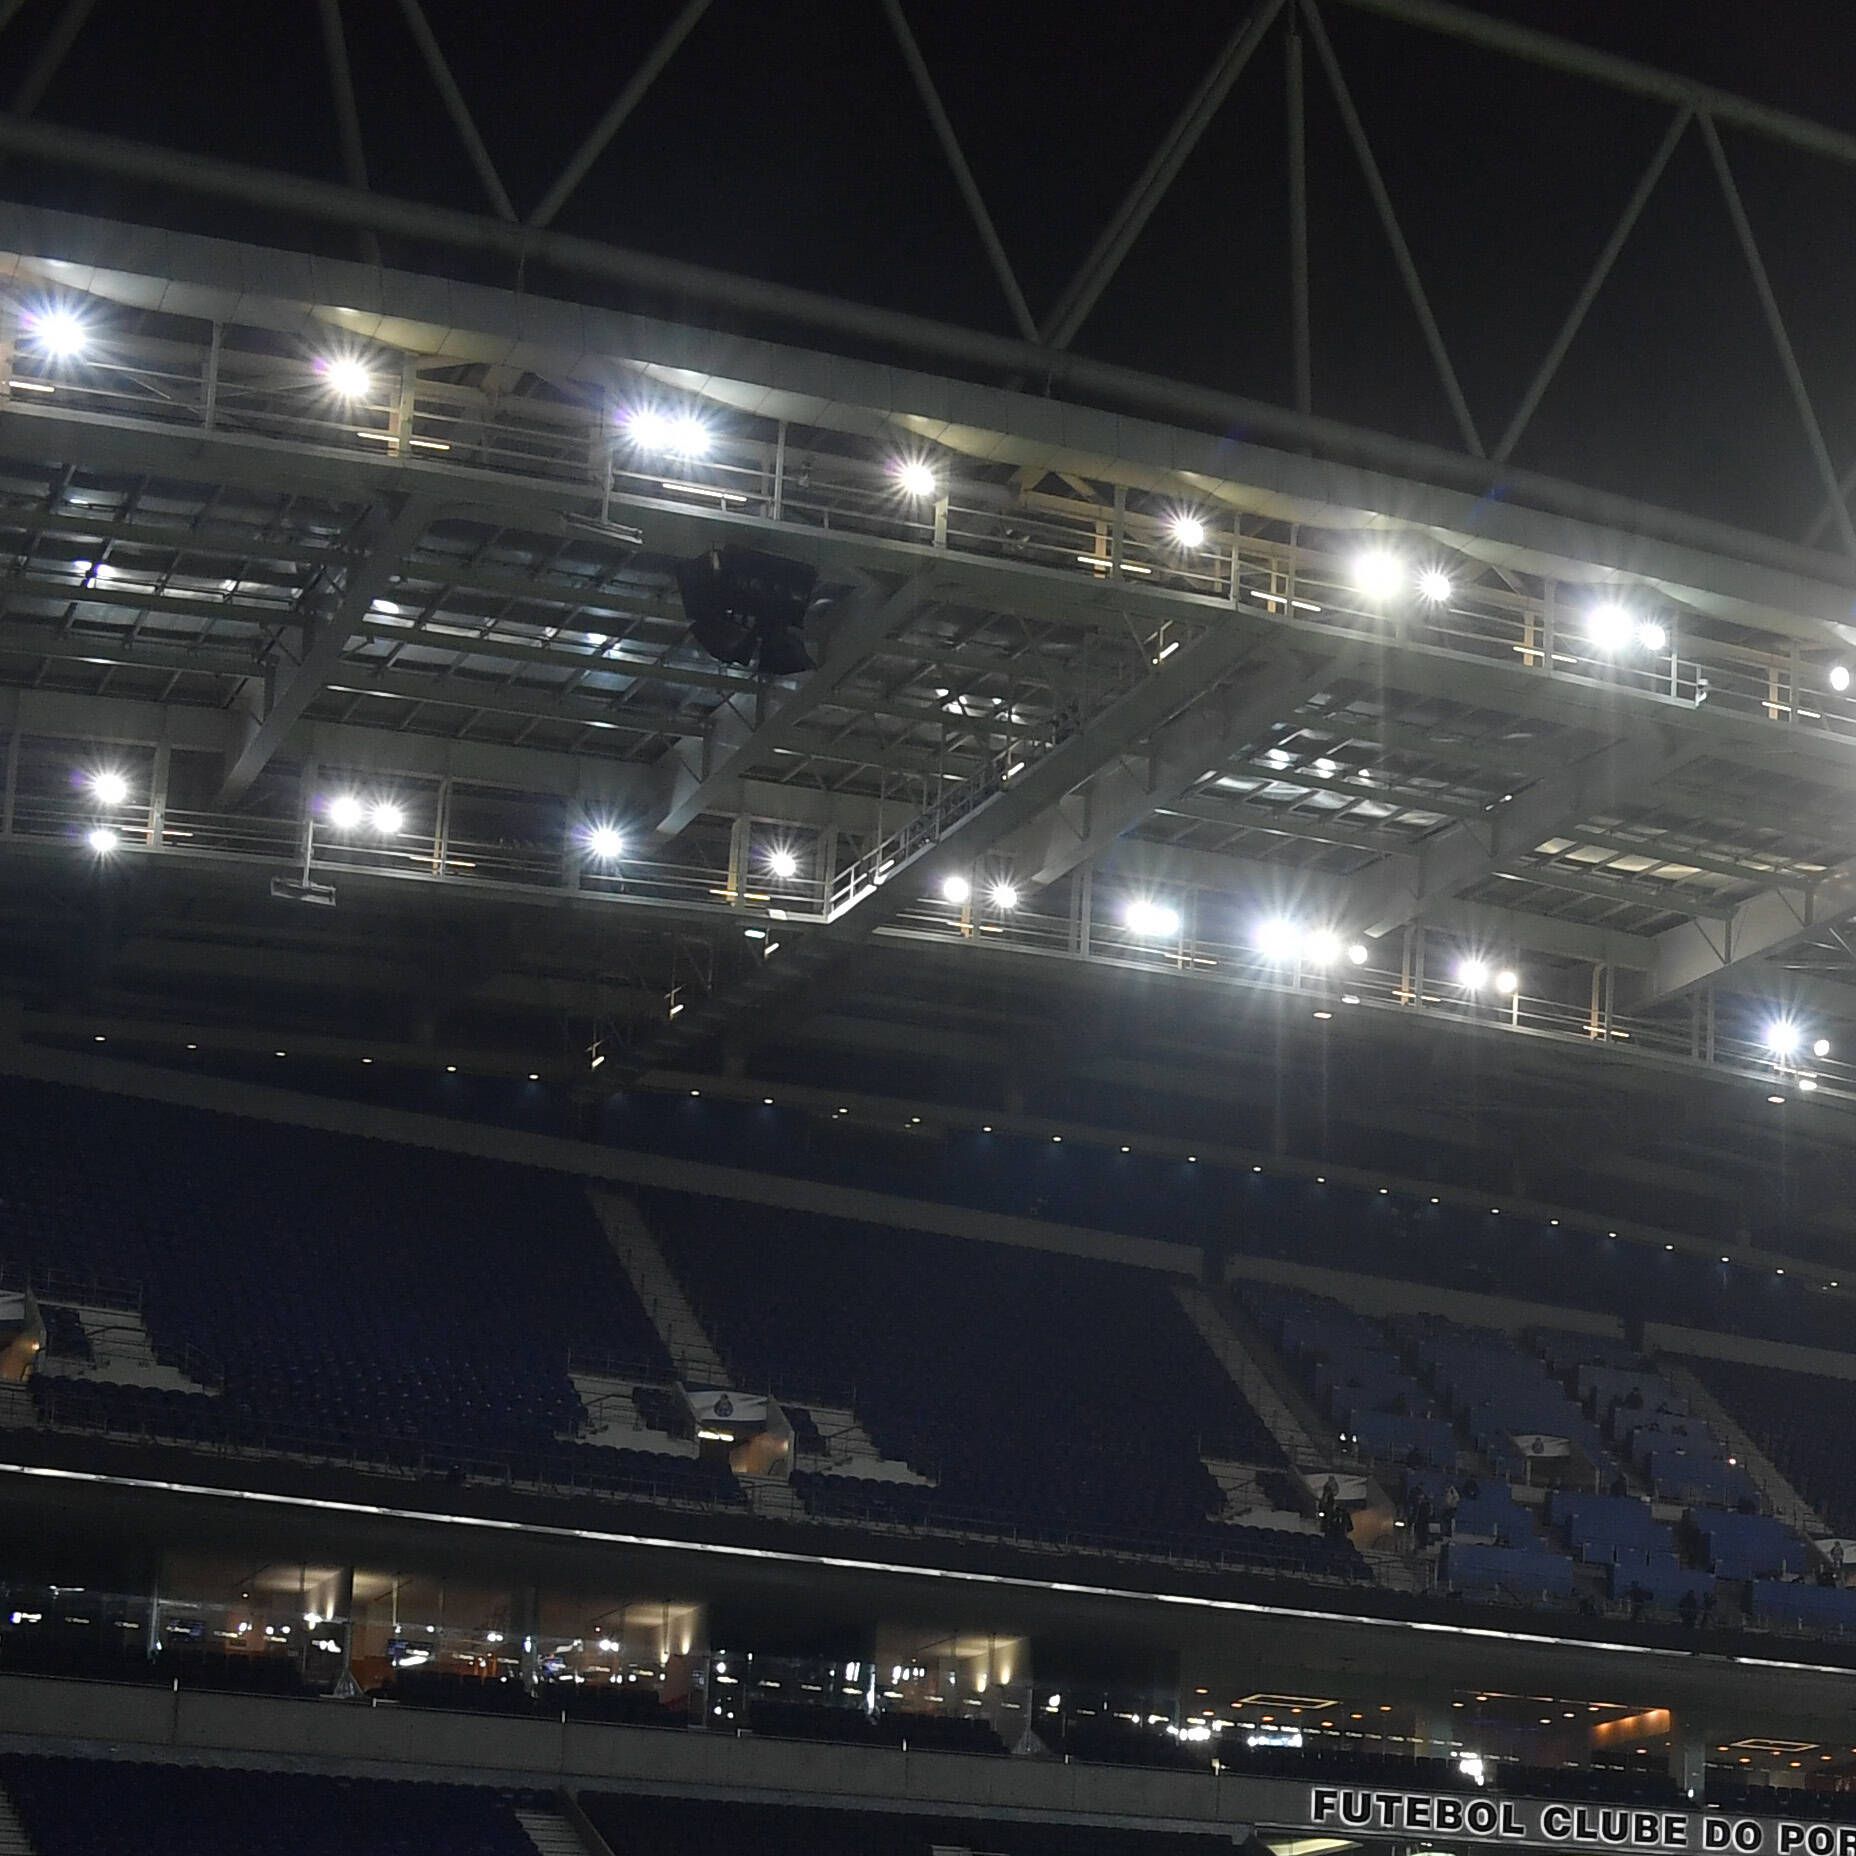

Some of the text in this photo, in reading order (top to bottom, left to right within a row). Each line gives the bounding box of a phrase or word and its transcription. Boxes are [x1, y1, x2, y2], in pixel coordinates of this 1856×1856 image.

[1311, 1787, 1525, 1837] FUTEBOL
[1540, 1804, 1688, 1847] CLUBE
[1703, 1816, 1762, 1853] DO
